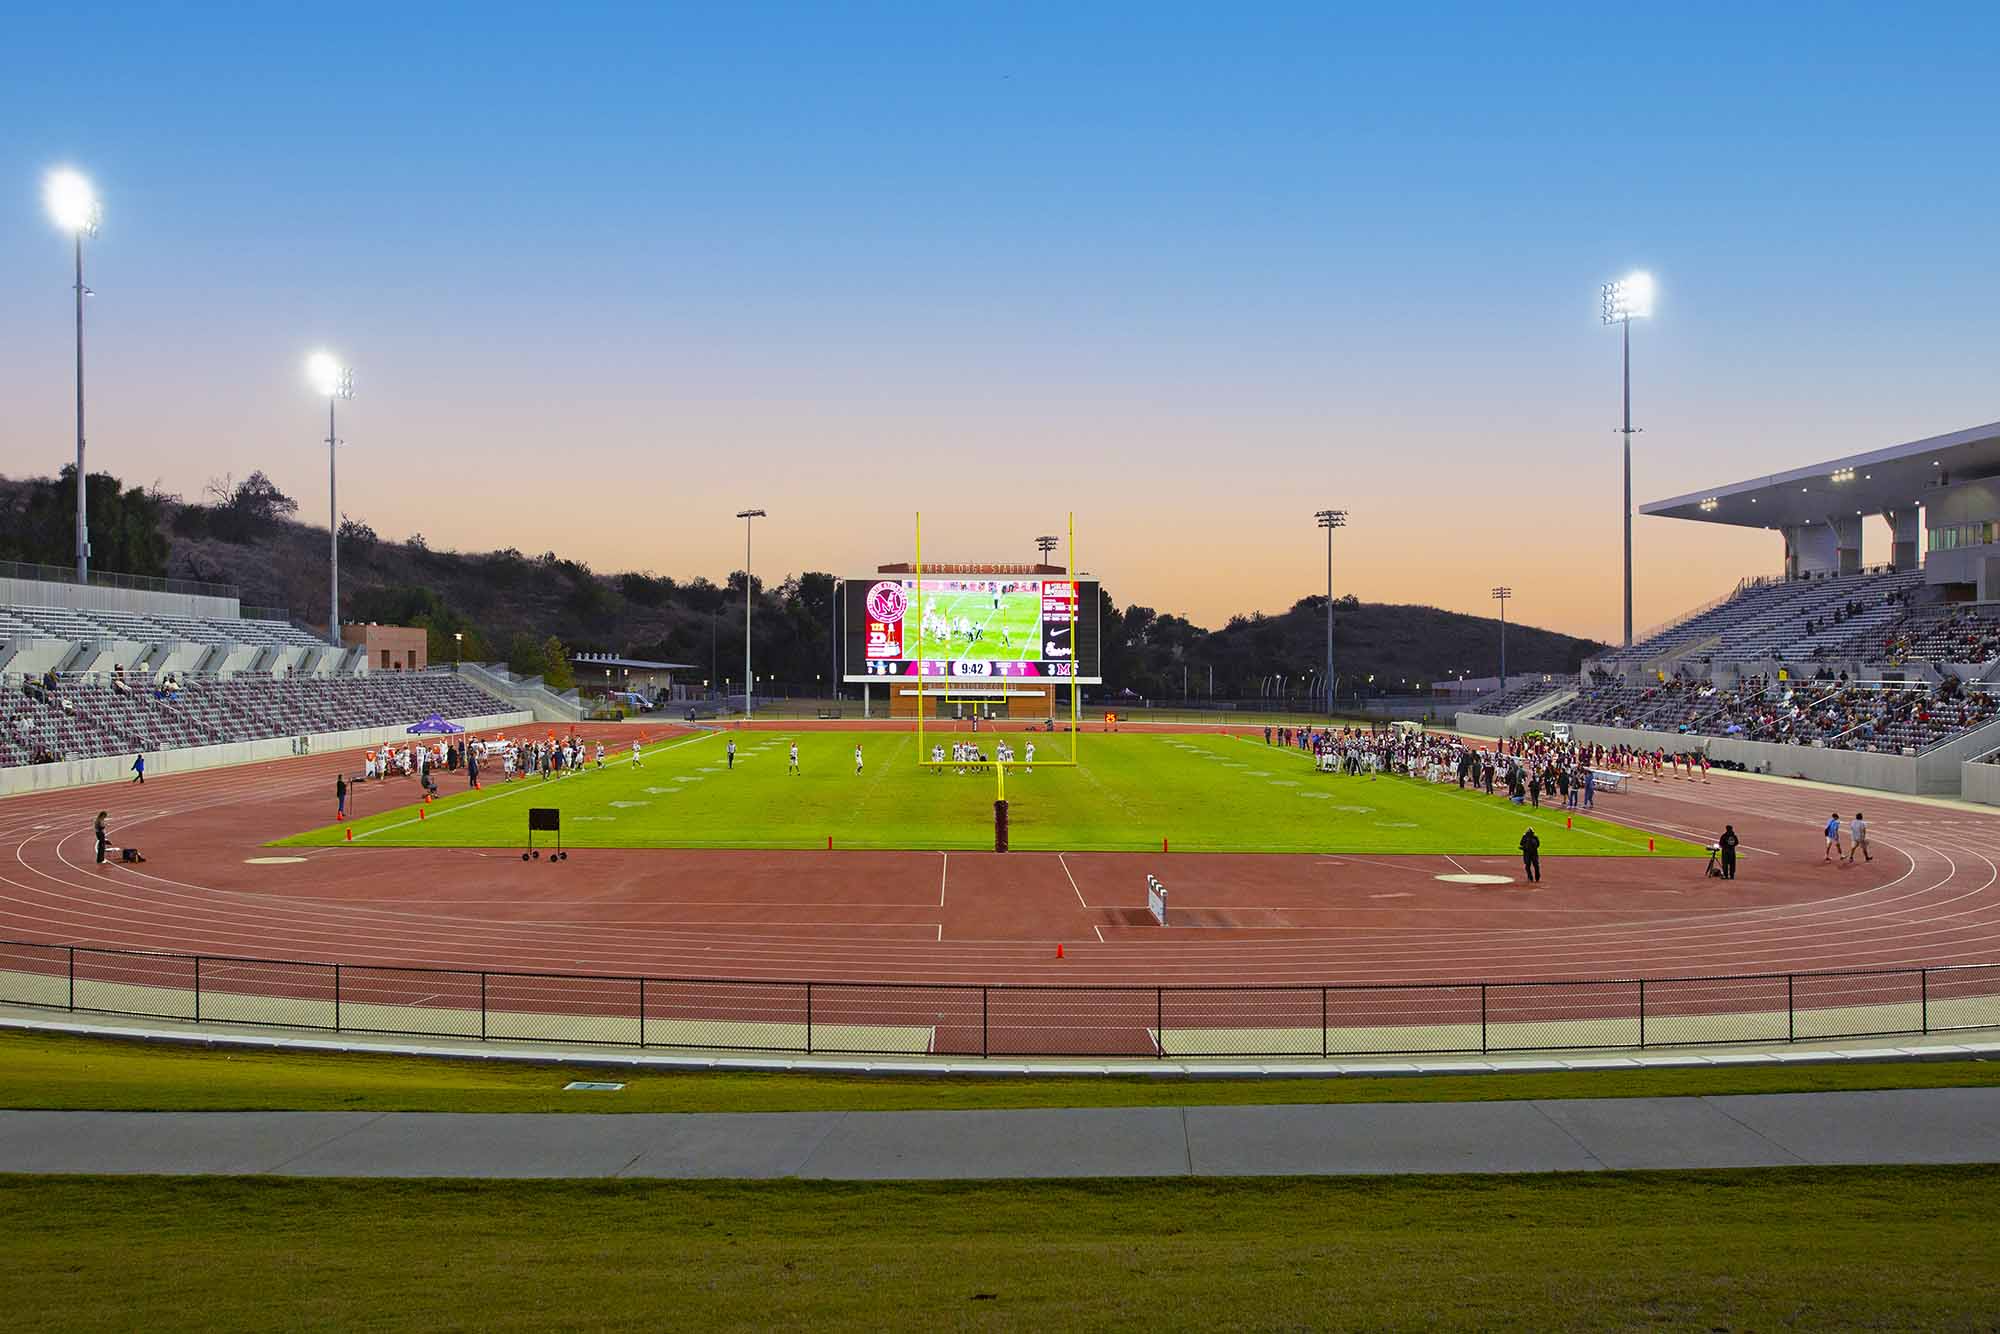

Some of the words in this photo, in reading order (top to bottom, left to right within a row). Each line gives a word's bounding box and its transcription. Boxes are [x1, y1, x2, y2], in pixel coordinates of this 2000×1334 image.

[908, 563, 945, 573] HLMER
[952, 563, 984, 573] LODGE
[991, 563, 1035, 573] STADIUM
[875, 591, 900, 615] M
[961, 663, 983, 674] 9:42
[1056, 663, 1071, 675] M
[1106, 714, 1115, 723] 25
